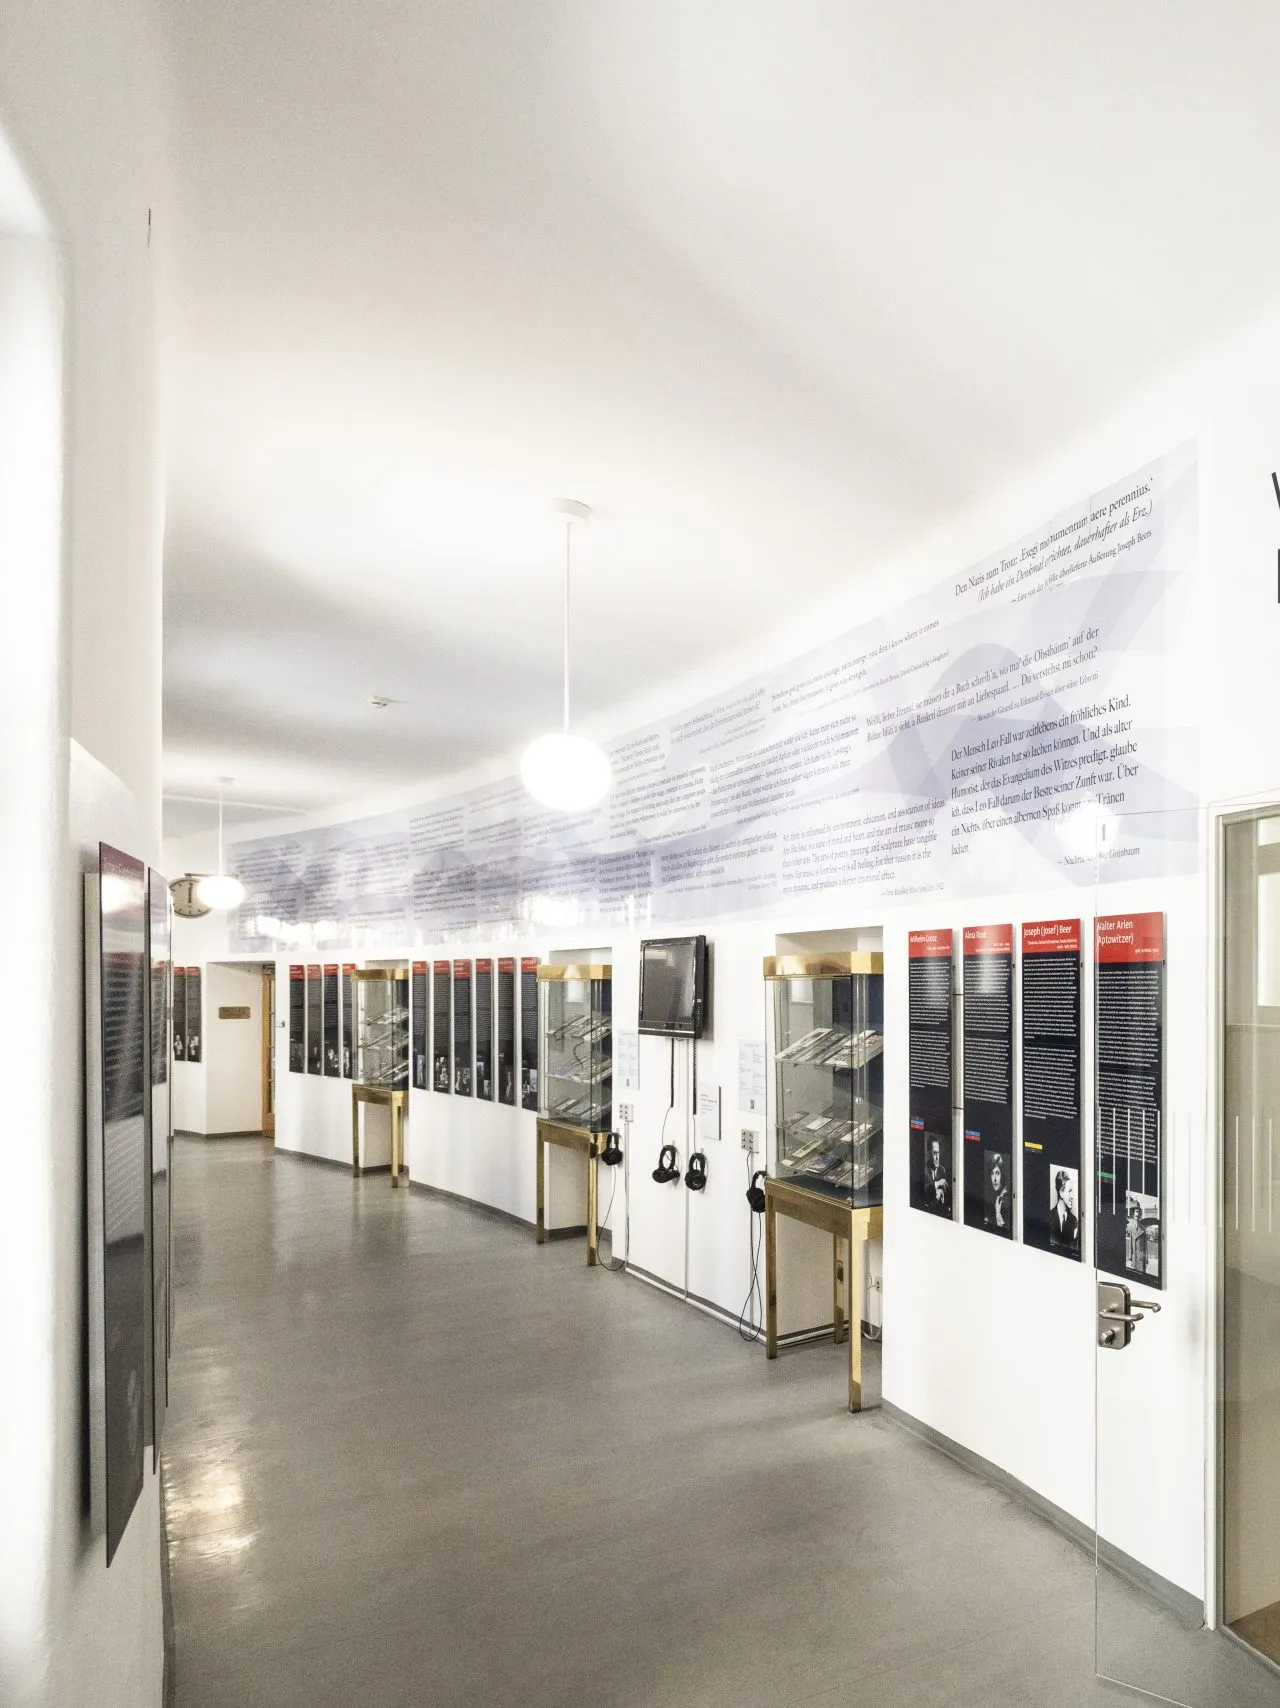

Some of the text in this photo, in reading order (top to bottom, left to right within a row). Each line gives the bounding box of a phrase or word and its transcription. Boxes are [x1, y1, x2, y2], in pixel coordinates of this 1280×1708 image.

[1118, 512, 1129, 528] als
[955, 584, 967, 596] Den
[1090, 507, 1106, 521] aere
[1117, 536, 1135, 554] Joseph
[1086, 628, 1099, 640] der
[1020, 674, 1030, 685] Du
[1072, 646, 1097, 665] schon?
[951, 750, 962, 761] Der
[962, 741, 986, 757] Mensch
[986, 739, 998, 750] Leo
[999, 732, 1012, 746] Fall
[1012, 731, 1026, 741] war
[1026, 721, 1057, 738] zeitlebens
[1058, 715, 1068, 727] ein
[1070, 705, 1106, 723] fröhliches
[951, 720, 1132, 780] Keiner seiner Rivalen hat so lachen können. Und als alter
[980, 780, 991, 791] der
[991, 777, 1001, 788] das
[1002, 768, 1039, 786] Evangelium
[1040, 763, 1052, 775] des
[1053, 759, 1077, 771] Witzes
[1110, 741, 1138, 761] glaube
[988, 796, 1000, 809] Fall
[1000, 794, 1020, 806] darum
[1021, 789, 1032, 801] der
[1034, 786, 1052, 798] Beste
[1053, 781, 1074, 793] seiner
[1075, 772, 1096, 789] Zunft
[1098, 772, 1114, 782] war.
[1117, 763, 1138, 779] Über
[951, 826, 960, 836] ein
[996, 816, 1012, 827] einen
[1013, 811, 1040, 823] albernen
[1042, 803, 1060, 820] Spaß
[1061, 801, 1083, 814] konnt
[1096, 792, 1125, 806] Tränen
[1064, 855, 1085, 865] Nachru
[1109, 847, 1139, 858] Grünbaum
[1024, 924, 1072, 938] Joseph (Josef) Beer
[1117, 919, 1133, 930] Arlen
[1096, 932, 1134, 946] Aptowitzer)
